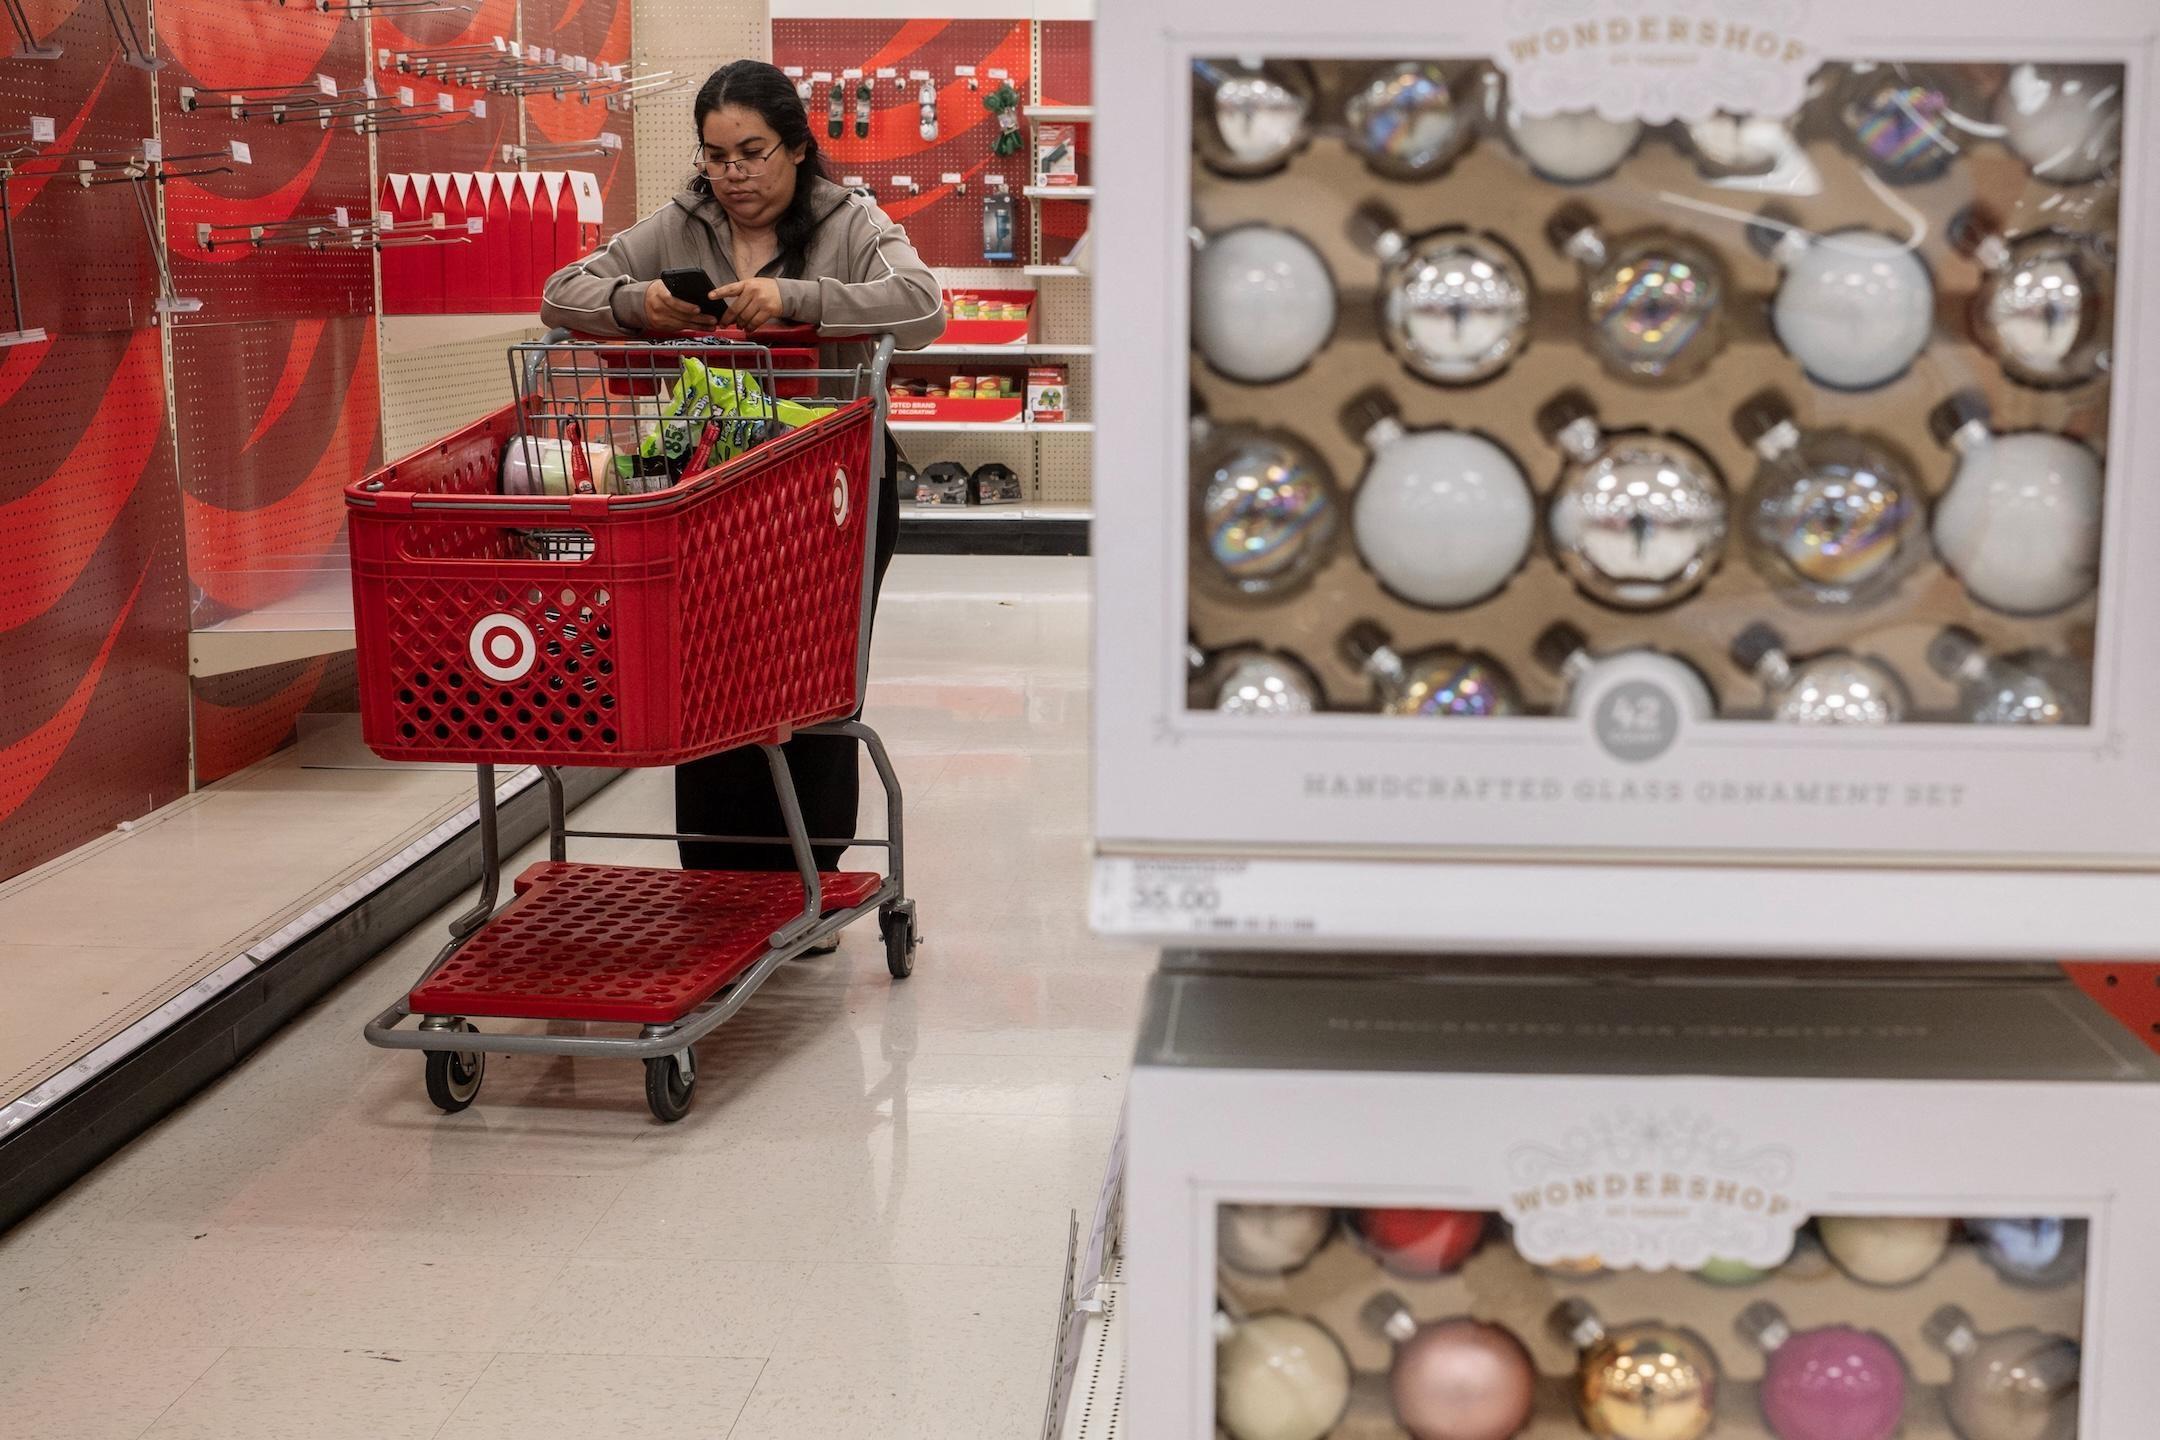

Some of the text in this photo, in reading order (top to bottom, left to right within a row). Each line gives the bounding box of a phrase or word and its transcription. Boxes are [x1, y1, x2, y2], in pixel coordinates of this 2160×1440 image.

[1508, 15, 1805, 62] WONDERSHOP
[664, 429, 685, 453] 85
[1612, 695, 1660, 729] 42
[1303, 773, 1967, 807] HANDCRAFTED GLASS ORNAMENT SET
[1512, 1171, 1791, 1217] WONDERSHOP
